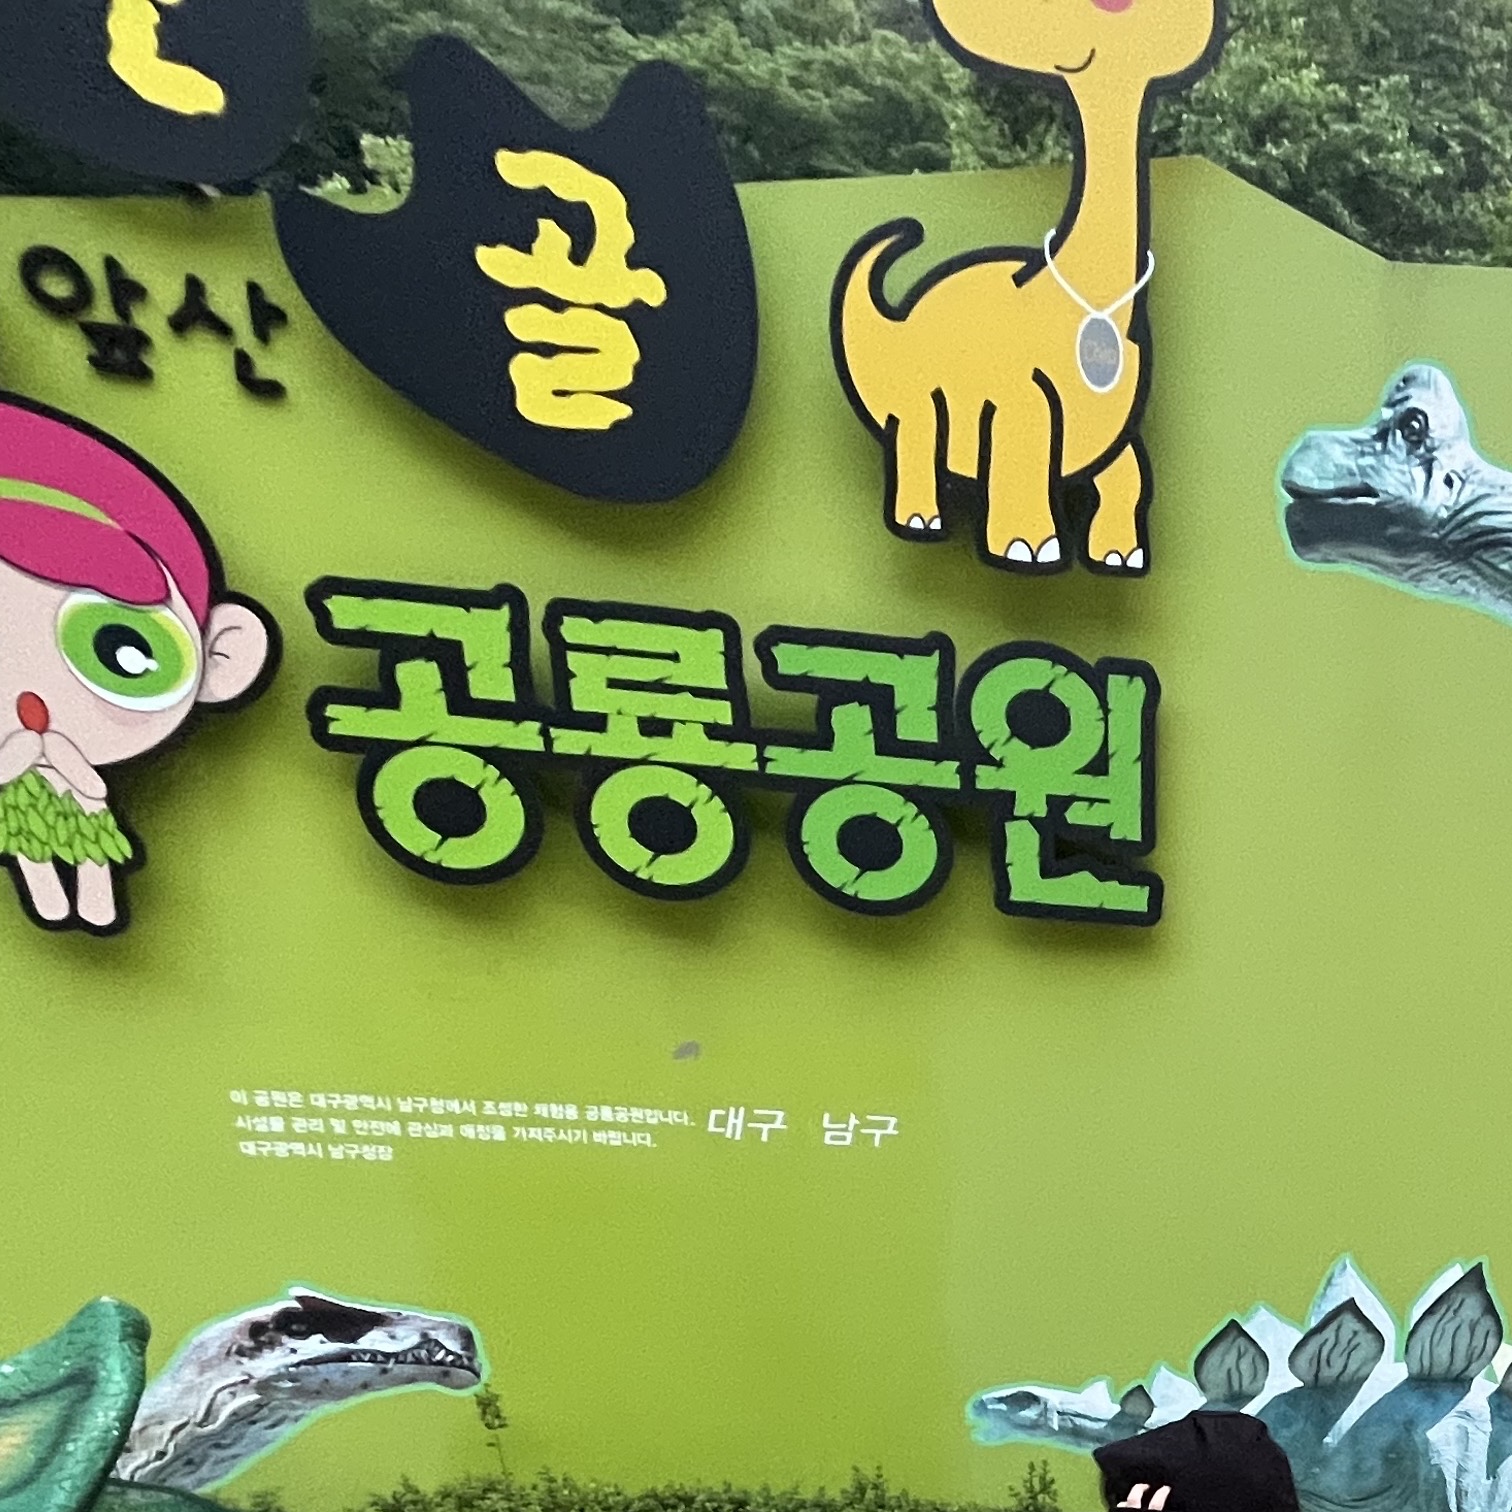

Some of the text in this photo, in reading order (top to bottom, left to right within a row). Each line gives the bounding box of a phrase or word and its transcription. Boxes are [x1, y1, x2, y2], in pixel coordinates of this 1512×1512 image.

[19, 244, 289, 401] 앞산
[318, 588, 1155, 917] 공룡공원
[229, 1089, 249, 1106] 이
[309, 1092, 392, 1112] 대구광역시
[396, 1096, 477, 1116] 남구청에서
[482, 1100, 529, 1118] 조성한
[585, 1104, 696, 1127] 공룡공원입니다.
[707, 1105, 899, 1147] 대구 남구
[239, 1140, 394, 1162] 대구광역시 남구청장
[291, 1116, 325, 1134] 관리
[592, 1129, 657, 1148] 바랍니다.
